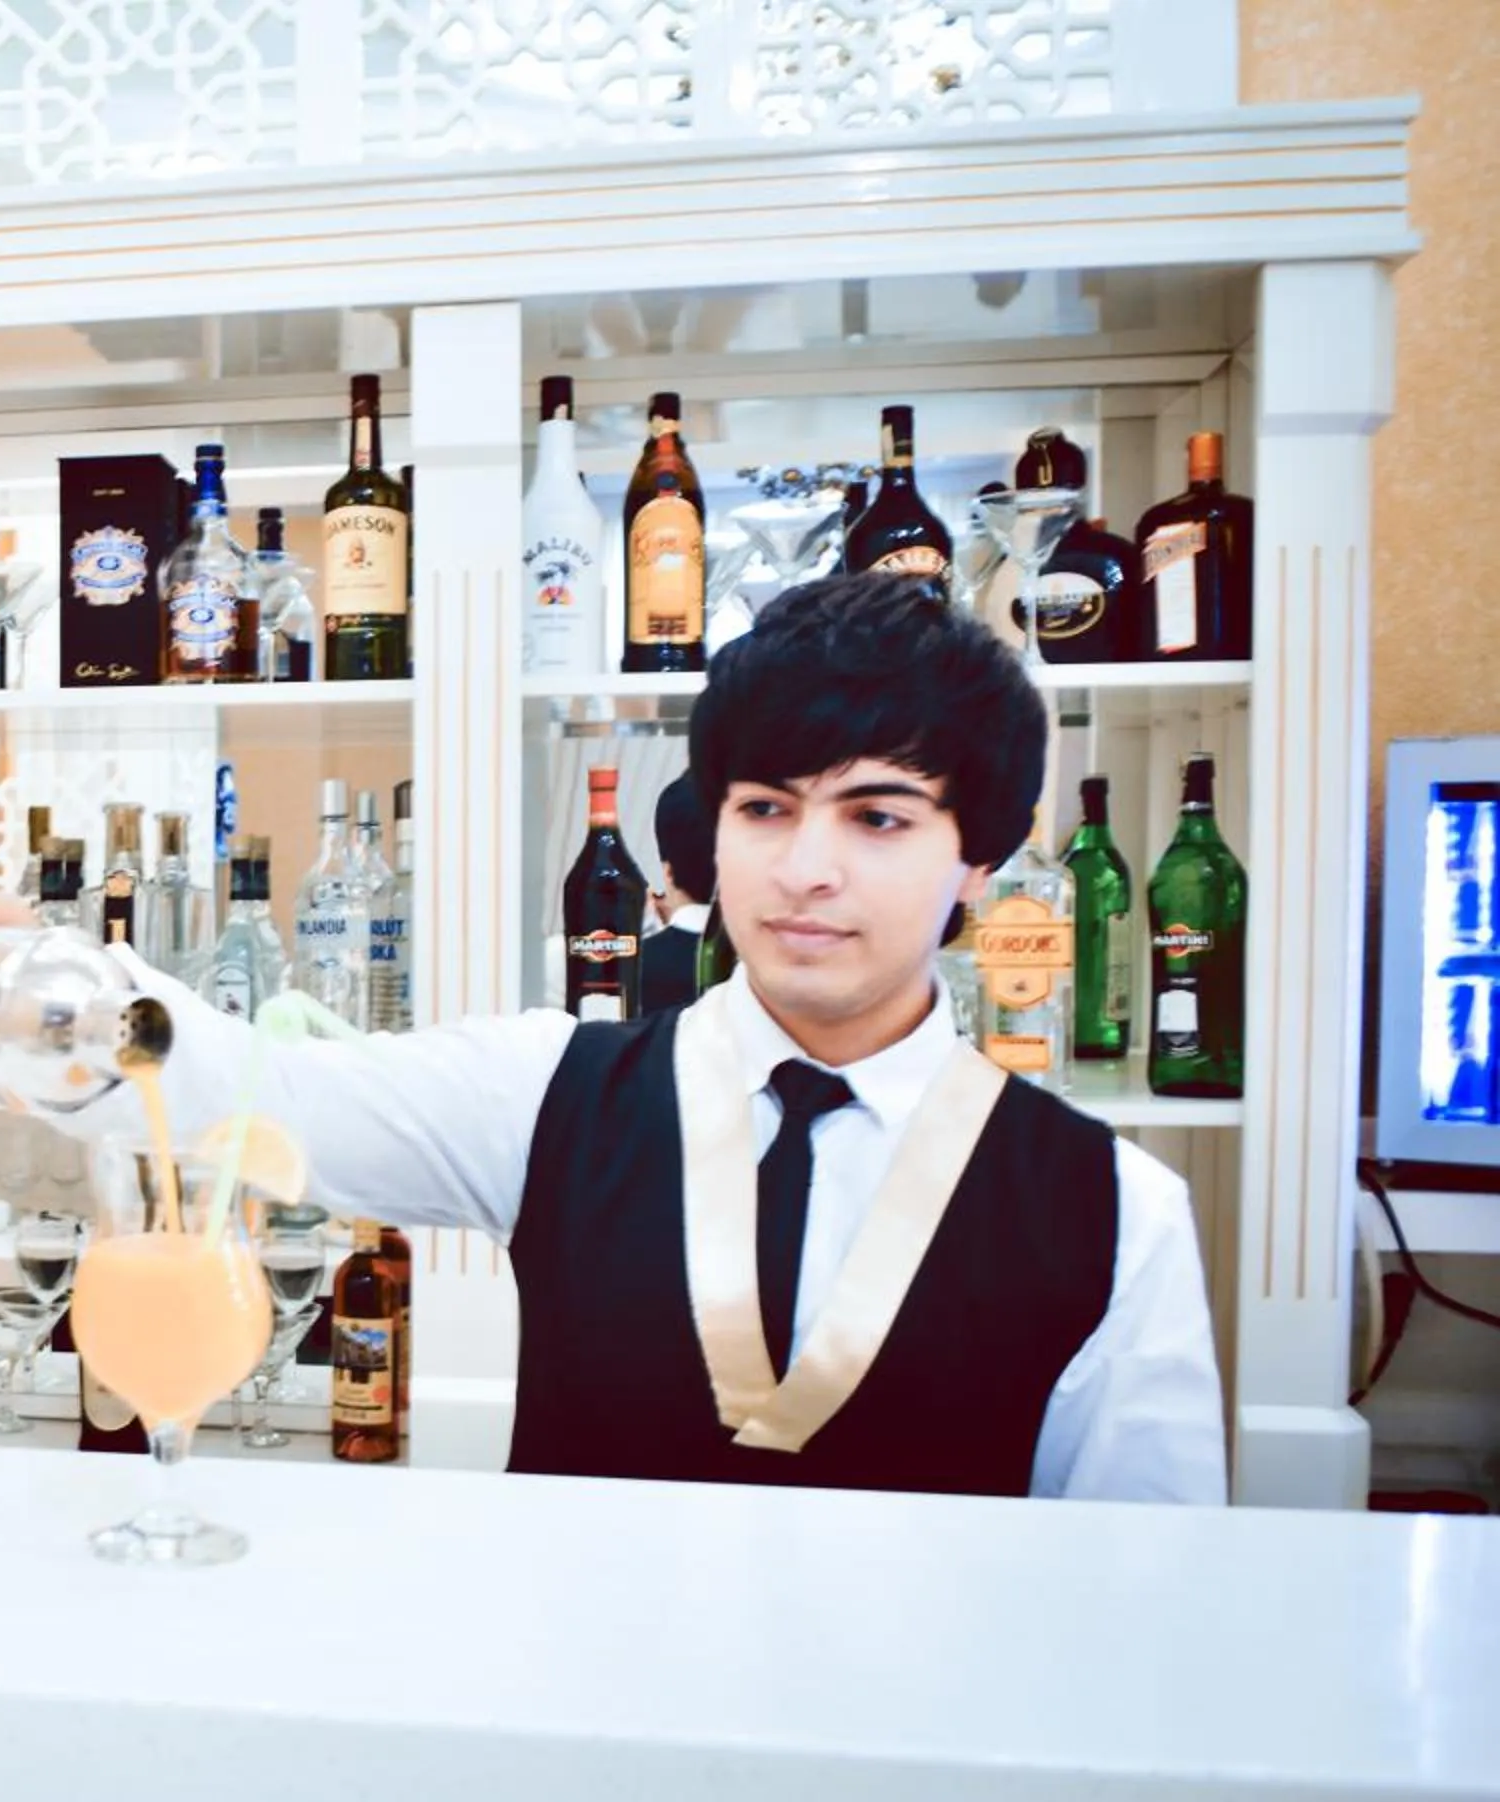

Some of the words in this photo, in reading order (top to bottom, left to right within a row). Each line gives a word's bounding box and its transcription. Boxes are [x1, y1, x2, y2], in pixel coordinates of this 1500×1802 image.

[327, 515, 396, 540] JAMESON
[522, 536, 593, 567] MALIBU
[369, 919, 405, 936] OLUT
[369, 945, 397, 960] DKA
